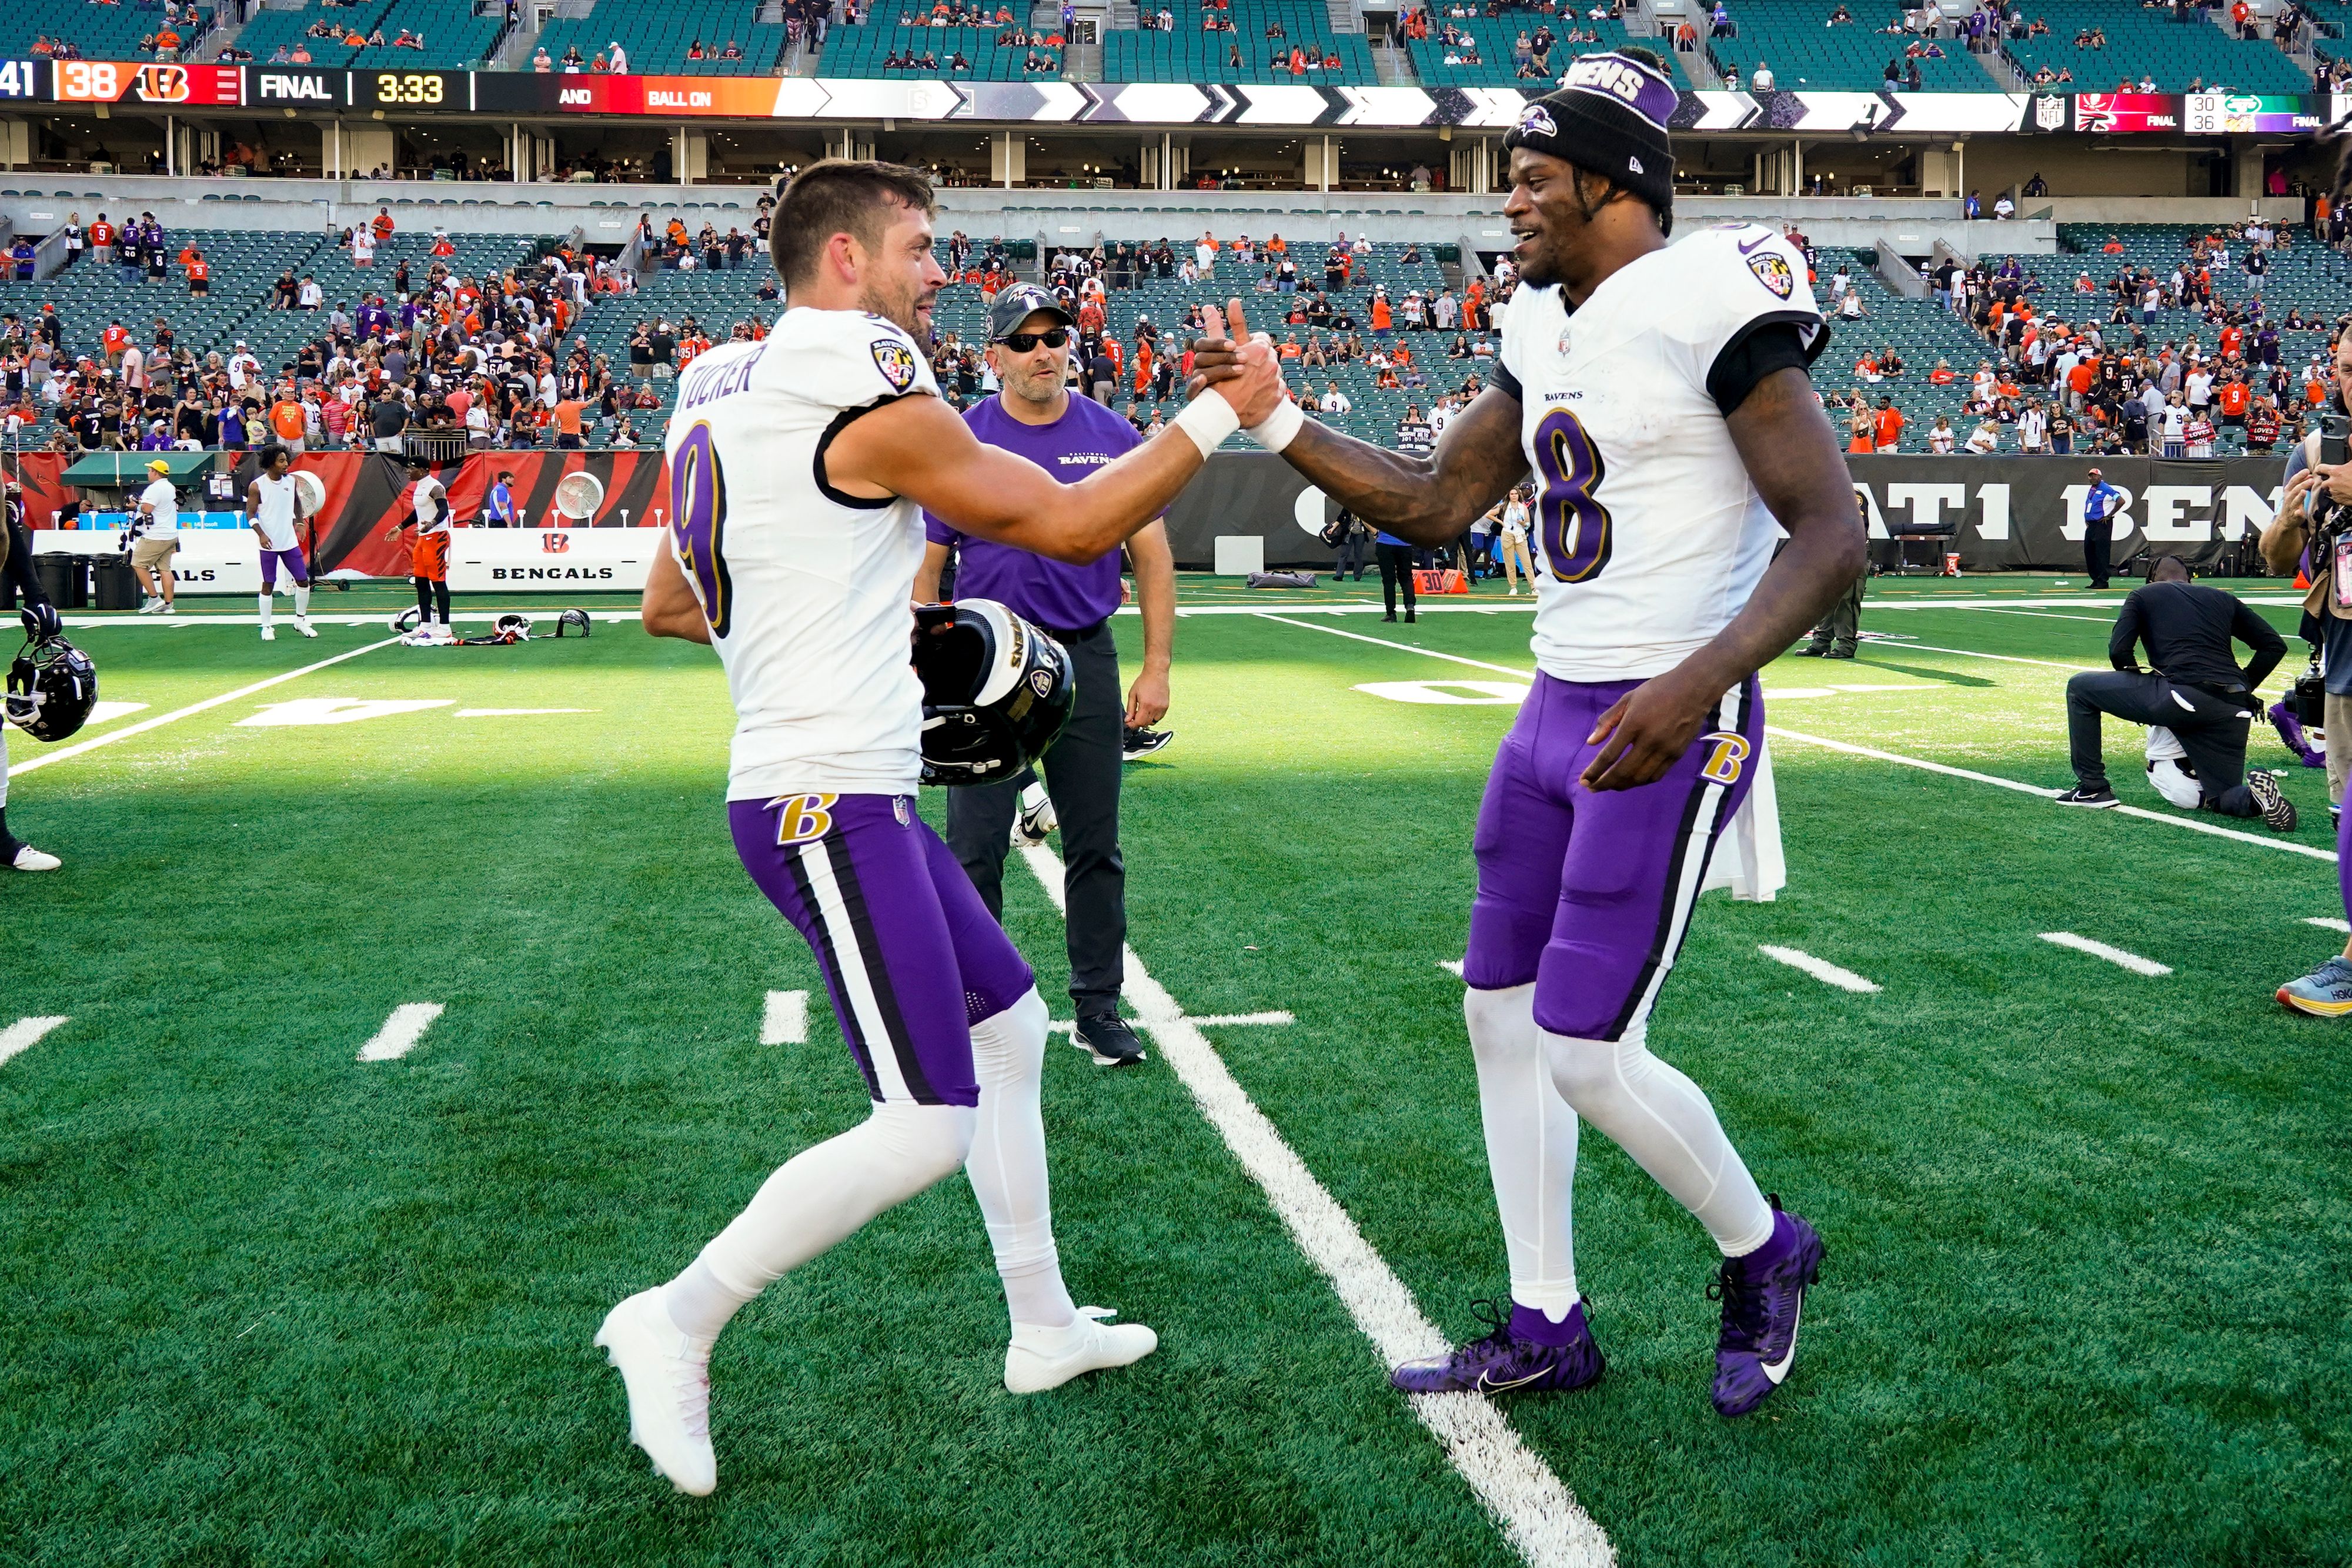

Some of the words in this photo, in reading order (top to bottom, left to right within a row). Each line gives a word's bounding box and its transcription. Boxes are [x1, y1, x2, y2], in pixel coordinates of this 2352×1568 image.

[0, 61, 34, 96] 41
[66, 63, 118, 99] 38
[1564, 61, 1645, 102] VENS
[260, 75, 332, 100] FINAL
[378, 75, 443, 103] 3:33
[559, 89, 592, 105] AND
[649, 91, 687, 107] BALL
[690, 92, 711, 107] ON
[2194, 97, 2214, 111] 30
[2040, 111, 2060, 124] NFL
[2147, 116, 2177, 127] FINAL
[2194, 116, 2214, 129] 36
[2292, 116, 2323, 128] FINAL
[99, 229, 106, 241] 9
[156, 255, 163, 266] 8
[1144, 254, 1150, 264] 9
[1748, 253, 1782, 264] RAVENS
[1808, 253, 1813, 263] 9
[1967, 285, 1976, 295] 18
[495, 307, 498, 319] 1
[1444, 305, 1449, 314] 9
[369, 312, 376, 321] 8
[111, 330, 117, 340] 9
[681, 348, 690, 359] 85
[1088, 347, 1092, 359] 1
[1113, 348, 1119, 362] 9
[234, 362, 240, 372] 9
[489, 364, 503, 375] 64
[2106, 367, 2113, 379] 9
[568, 378, 574, 390] 9
[679, 343, 768, 413] TUCKER
[2122, 379, 2132, 391] 91
[2278, 379, 2282, 392] 1
[1545, 391, 1583, 401] RAVENS
[2232, 390, 2239, 403] 9
[1331, 401, 1337, 412] 9
[2000, 411, 2009, 420] 9
[2176, 414, 2183, 424] 9
[92, 419, 99, 434] 2
[1437, 417, 1444, 430] 9
[1881, 416, 1885, 429] 1
[2034, 422, 2038, 434] 1
[2189, 429, 2210, 438] LOVES
[2193, 437, 2208, 446] YOU
[1533, 407, 1612, 584] 8
[670, 419, 733, 639] 9
[493, 568, 613, 579] BENGALS
[1422, 573, 1442, 591] 30
[1700, 731, 1751, 784] B
[763, 793, 839, 845] B
